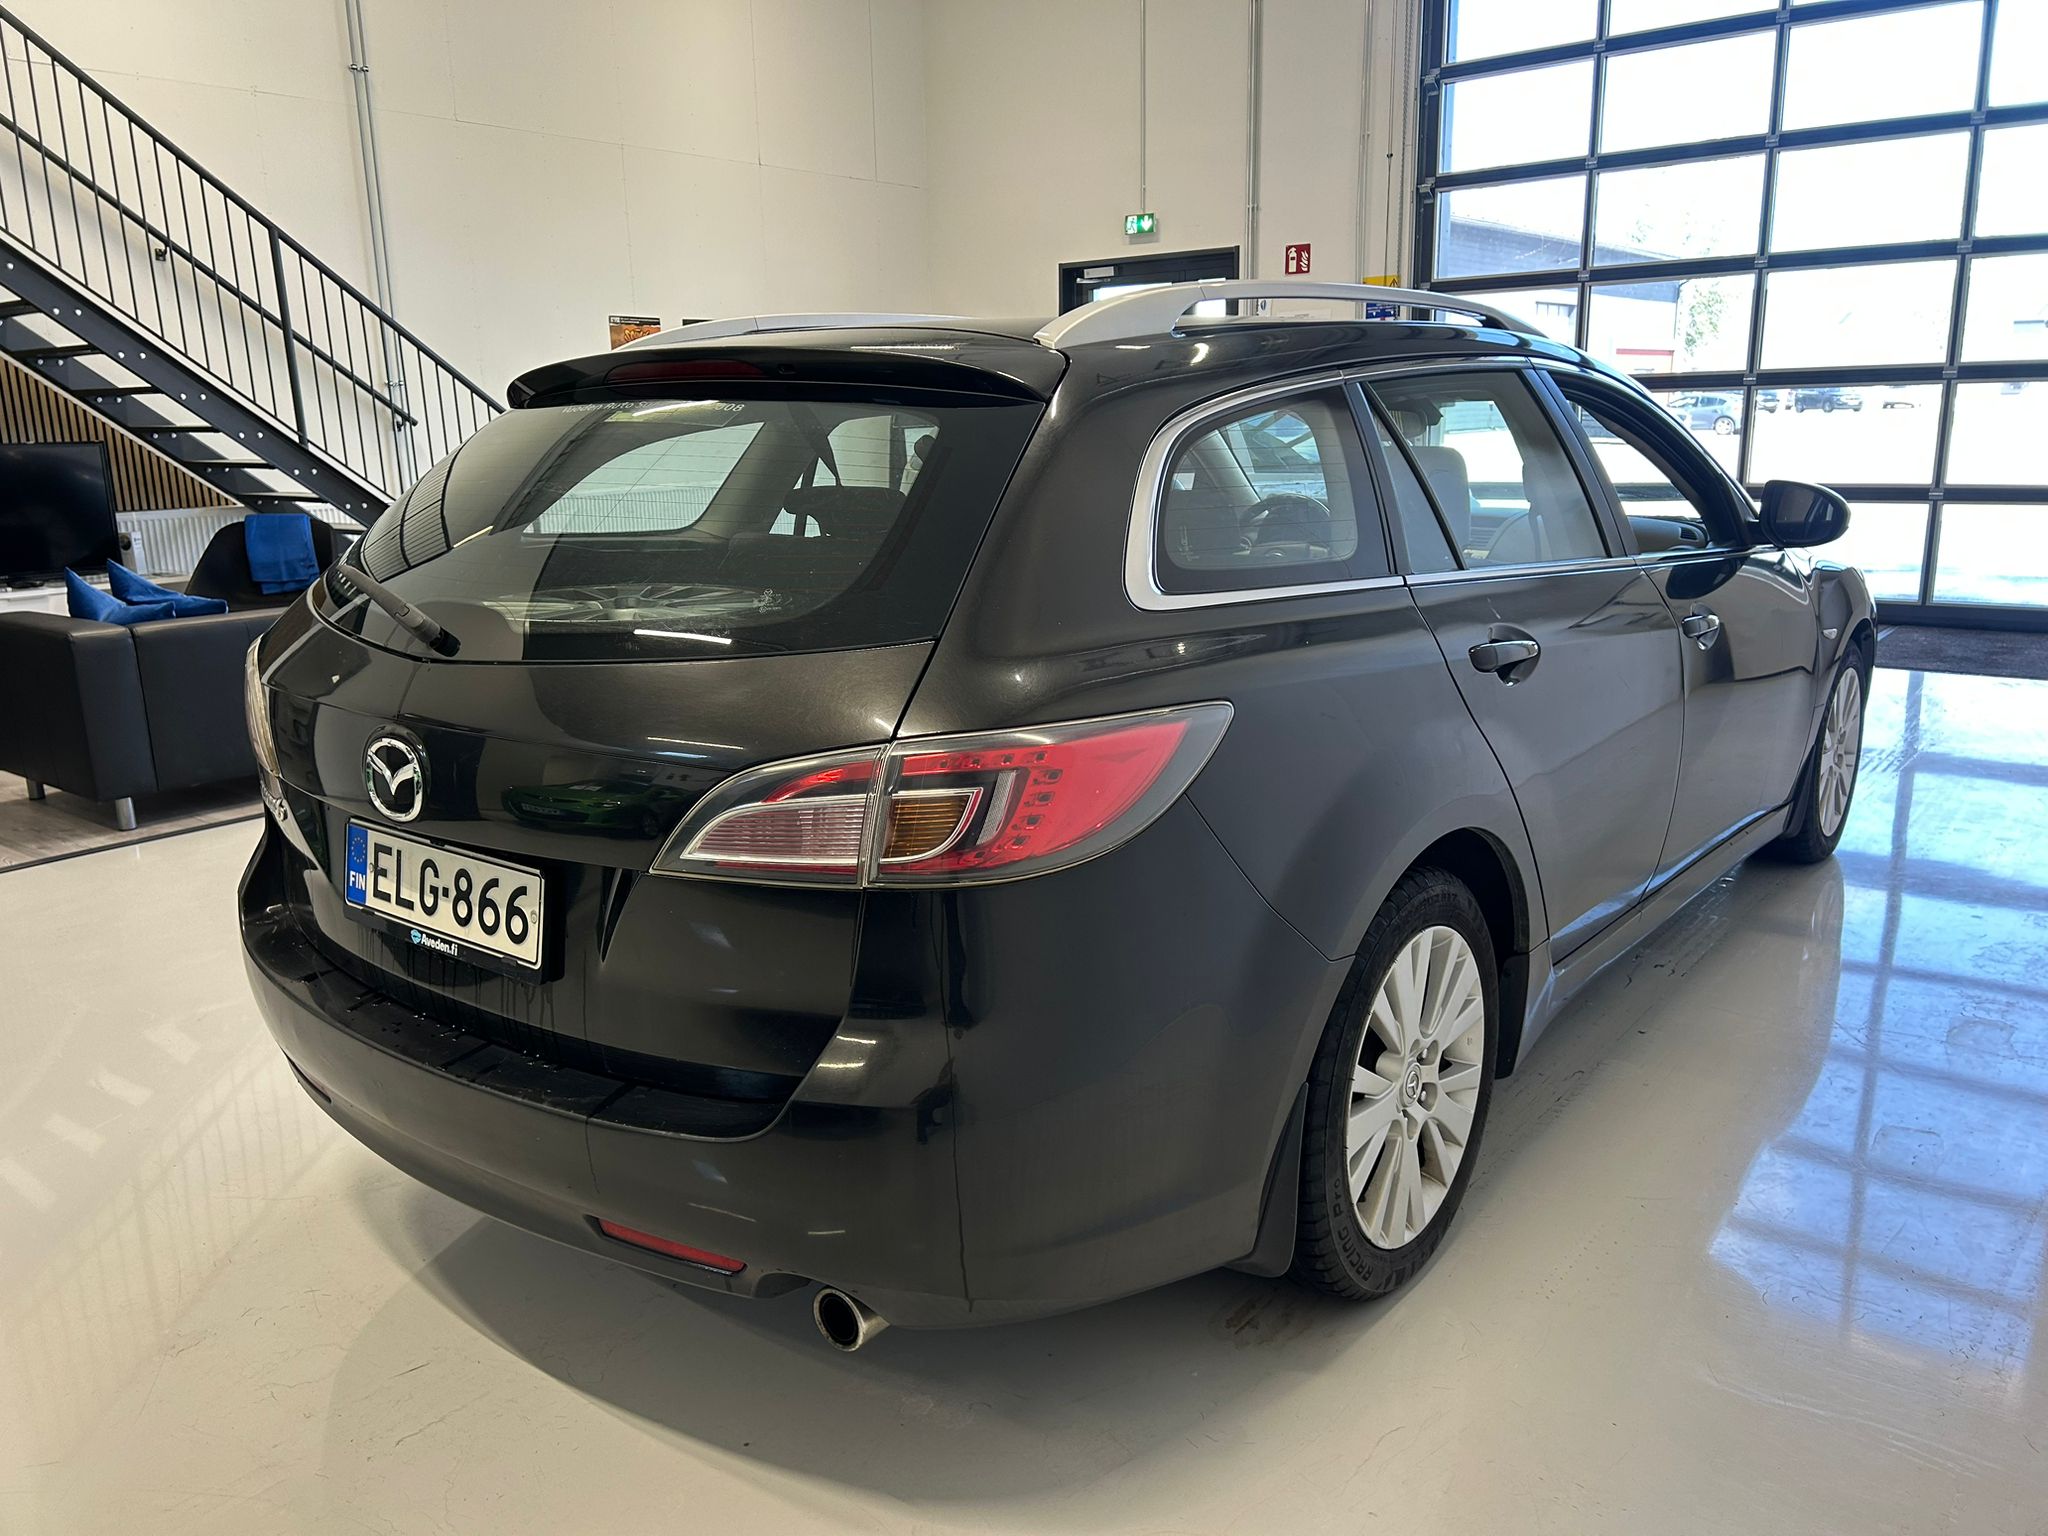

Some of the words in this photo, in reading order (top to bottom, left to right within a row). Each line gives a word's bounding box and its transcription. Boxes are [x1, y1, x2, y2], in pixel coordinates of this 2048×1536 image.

[604, 401, 634, 411] Auto
[349, 870, 366, 891] FIN
[373, 842, 530, 946] ELG-866
[420, 932, 459, 957] Aveden.fi
